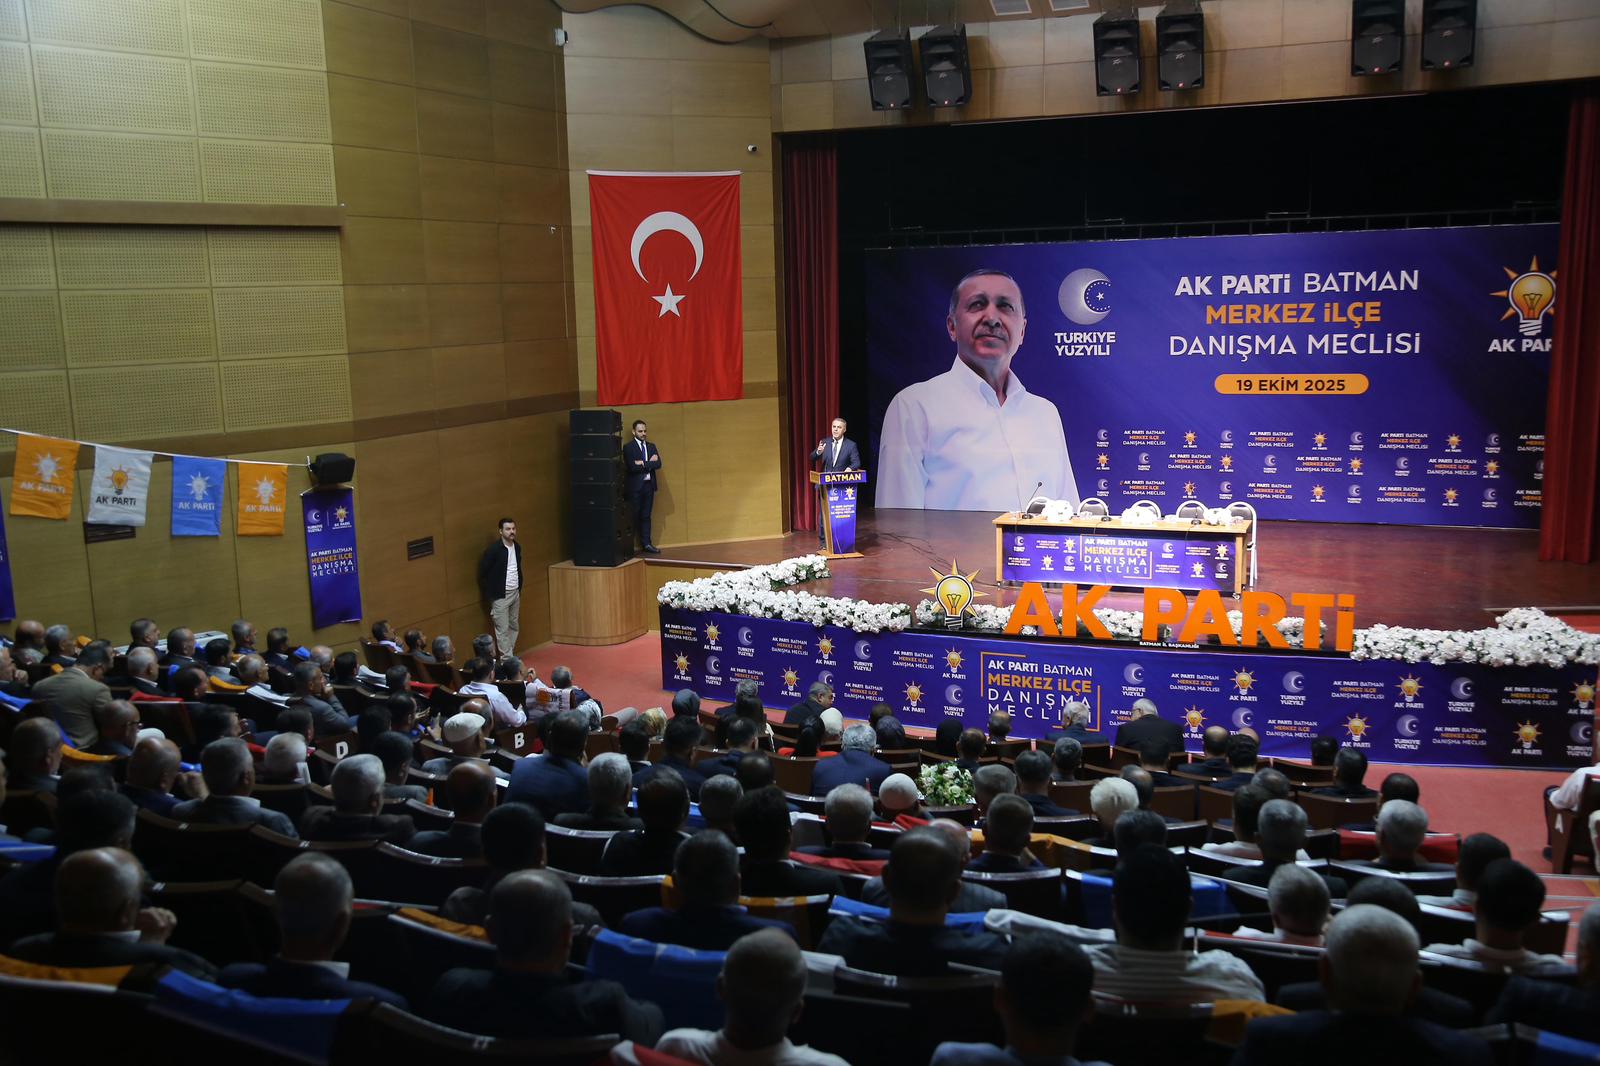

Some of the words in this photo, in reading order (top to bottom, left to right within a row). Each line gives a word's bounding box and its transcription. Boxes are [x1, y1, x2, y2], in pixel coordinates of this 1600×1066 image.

[1175, 276, 1213, 296] AK
[1304, 270, 1418, 293] BATMAN
[1206, 303, 1315, 324] MERKEZ
[1169, 335, 1296, 362] DANIŞMA
[1488, 339, 1516, 352] AK
[1521, 339, 1553, 352] PAR
[1236, 379, 1252, 391] 19
[1259, 376, 1298, 391] EKİM
[1304, 379, 1345, 391] 2025
[20, 481, 34, 490] AK
[825, 473, 861, 482] BATMAN
[96, 495, 109, 504] AK
[1085, 546, 1124, 555] MERKEZ
[1118, 539, 1148, 547] BATMAN
[1084, 555, 1147, 567] DANIŞMA
[1003, 582, 1114, 640] AK
[988, 660, 1004, 670] AK
[1044, 664, 1092, 676] BATMAN
[988, 672, 1053, 690] MERKEZ
[988, 703, 1091, 723] MECLİİ
[514, 732, 525, 749] B
[336, 741, 348, 760] D
